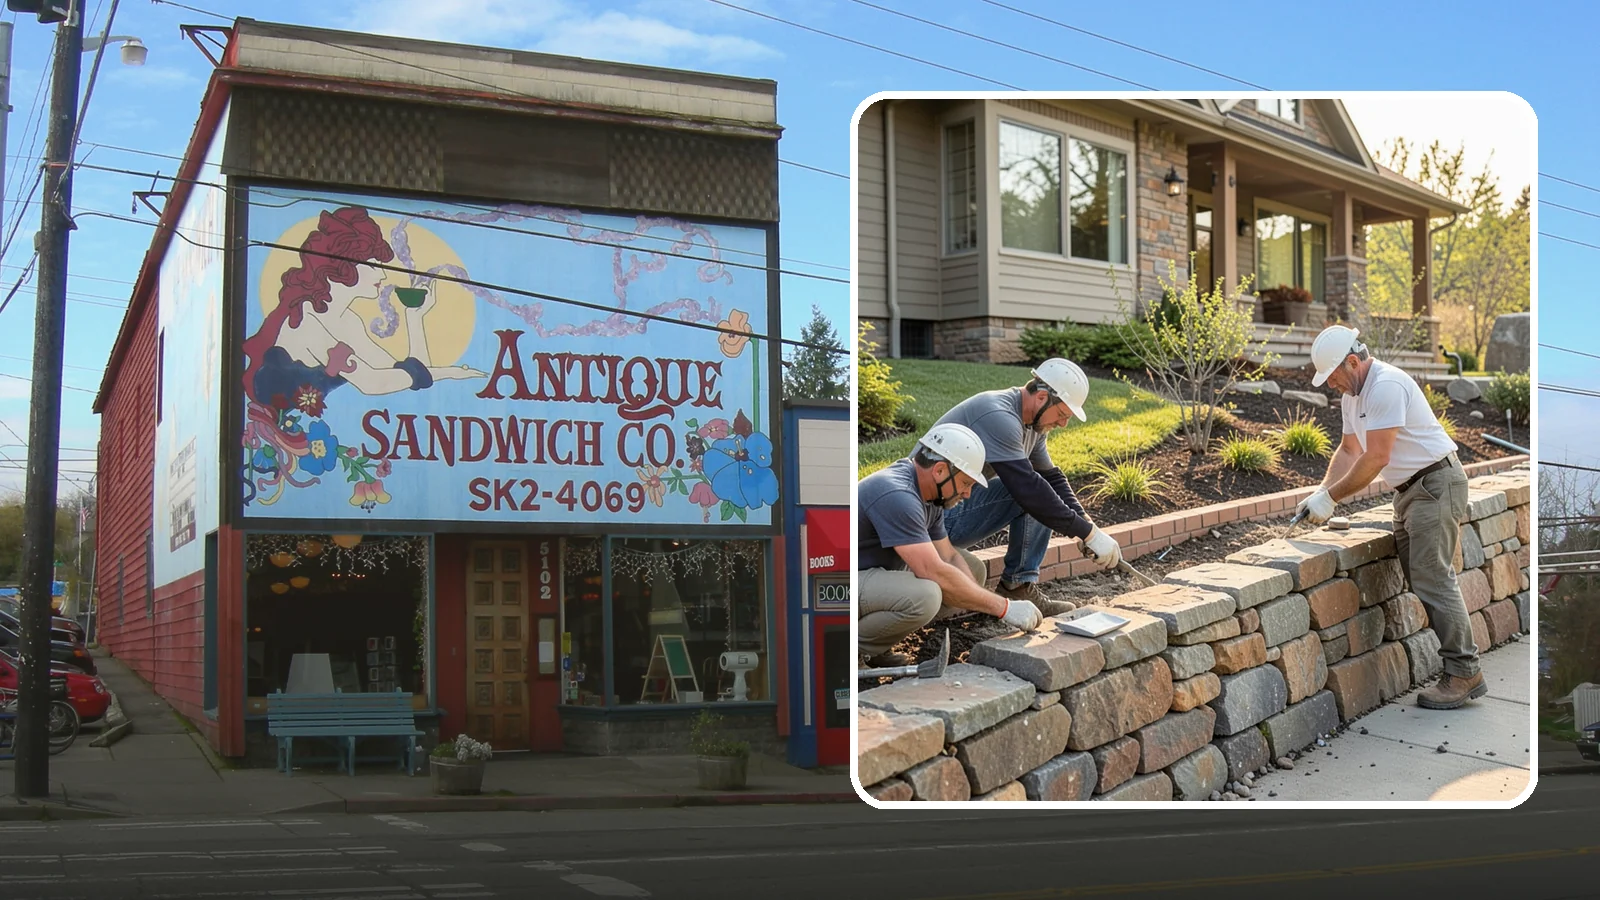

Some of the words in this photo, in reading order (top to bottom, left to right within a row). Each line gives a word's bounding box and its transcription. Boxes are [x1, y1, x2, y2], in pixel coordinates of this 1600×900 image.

[476, 329, 723, 421] ANTIQUE
[361, 409, 604, 467] SANDWICH
[617, 422, 685, 468] CO.
[468, 477, 646, 513] SK2-4069
[540, 541, 551, 600] 5102
[809, 555, 835, 569] BOOKS
